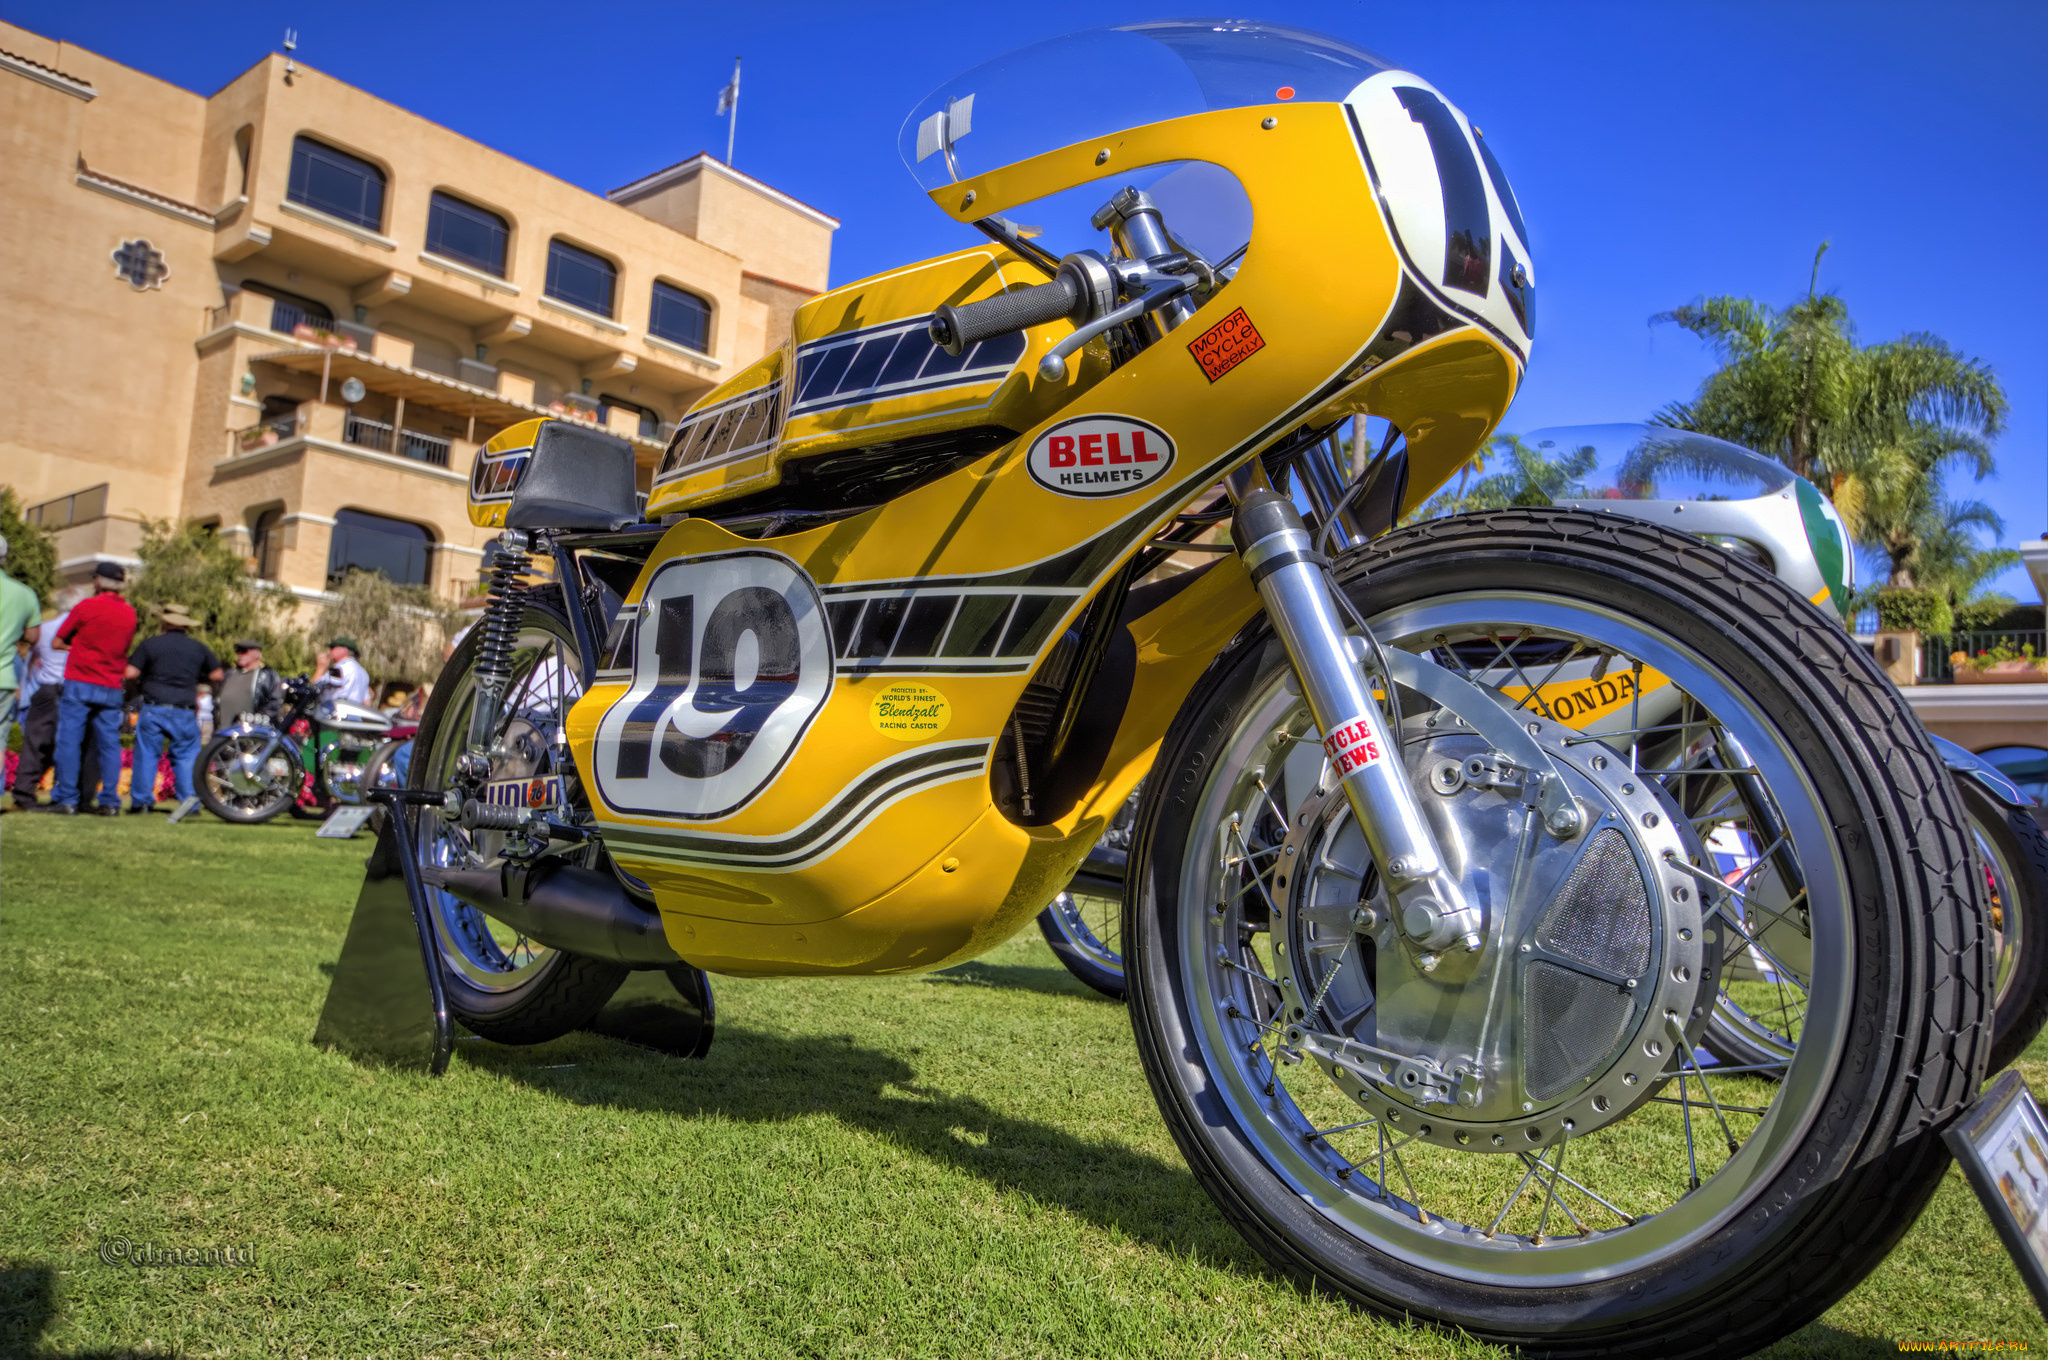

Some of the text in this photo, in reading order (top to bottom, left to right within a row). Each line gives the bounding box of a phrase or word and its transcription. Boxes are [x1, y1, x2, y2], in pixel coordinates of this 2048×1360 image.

[1194, 312, 1245, 354] MOTOR
[1049, 431, 1159, 468] BELL
[1060, 469, 1144, 485] HELMETS
[616, 586, 801, 779] 19
[1530, 673, 1642, 720] HONDA
[1323, 720, 1372, 759] CYCLE
[1332, 741, 1380, 780] NEWS
[529, 786, 543, 801] 76
[1852, 896, 1882, 1076] DUNLOP
